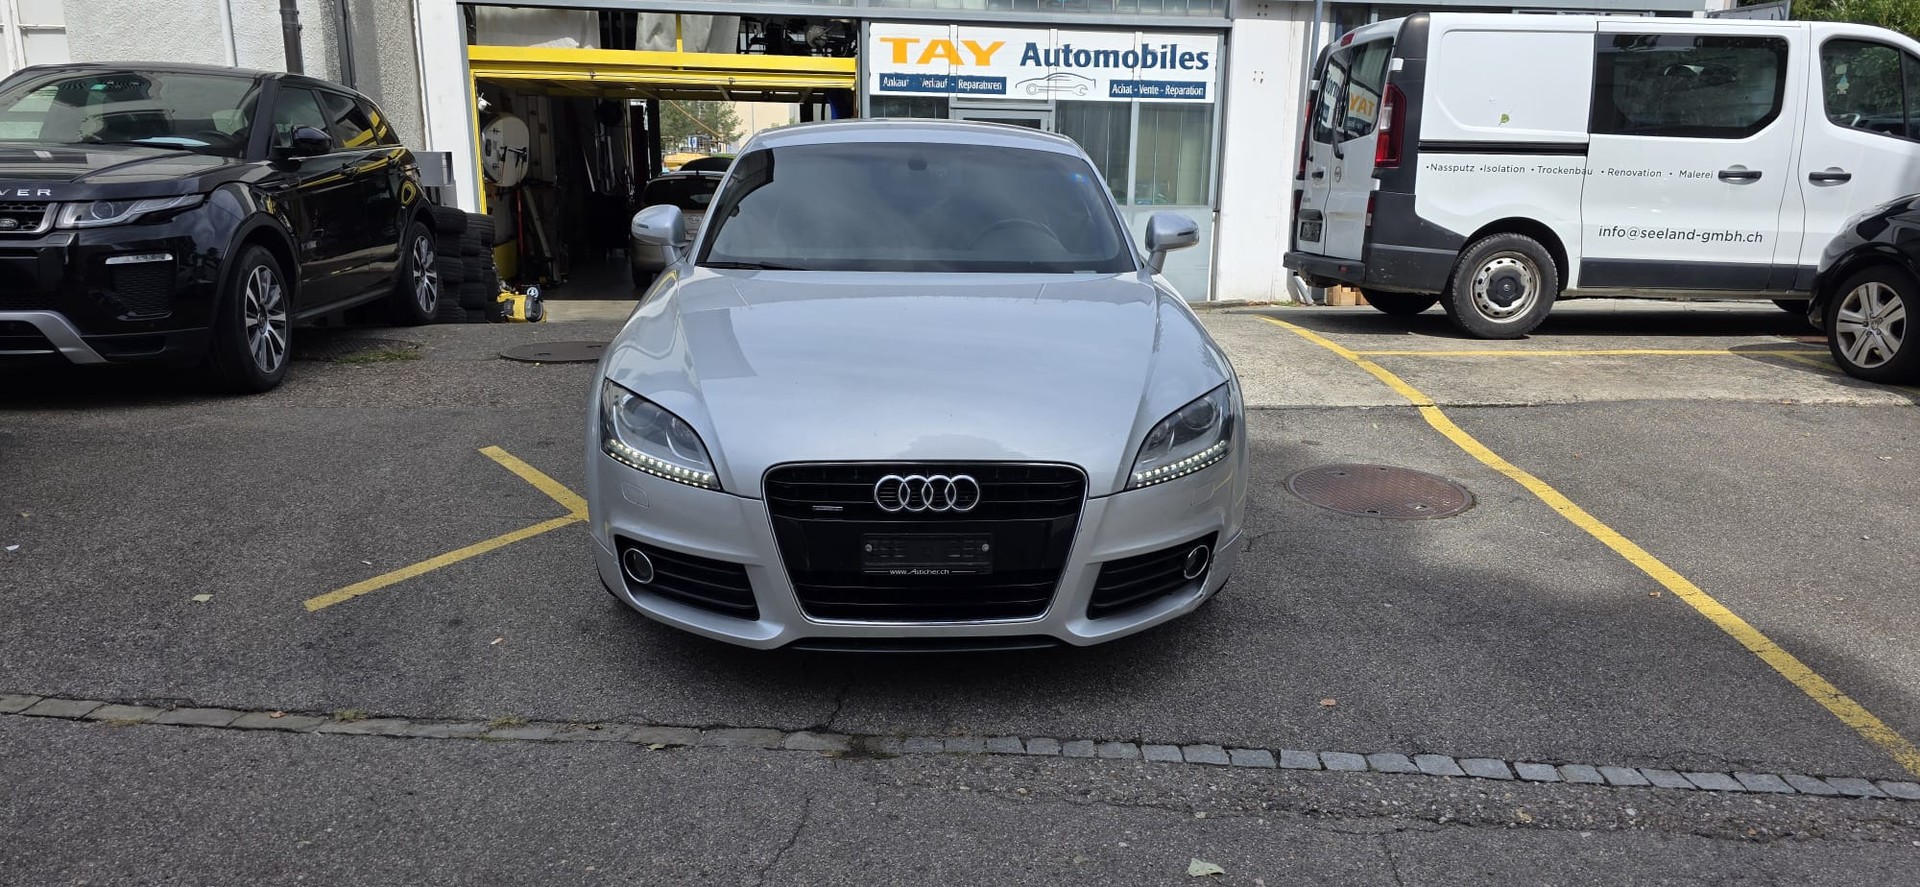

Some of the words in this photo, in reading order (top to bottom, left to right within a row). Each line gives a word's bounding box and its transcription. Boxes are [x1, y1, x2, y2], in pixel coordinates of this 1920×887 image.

[880, 37, 1005, 67] TAY
[1020, 42, 1209, 70] Automobiles
[957, 79, 1002, 91] Reparaturen
[1111, 83, 1133, 94] Achat
[1139, 84, 1159, 95] Vente
[1430, 163, 1475, 173] Nassputz
[1483, 164, 1525, 173] Isolation
[1537, 165, 1593, 176] Trockenbau
[1607, 168, 1662, 178] Renovation
[1678, 170, 1714, 179] Malerei
[1598, 225, 1763, 243] info@seeland-gmbh.ch
